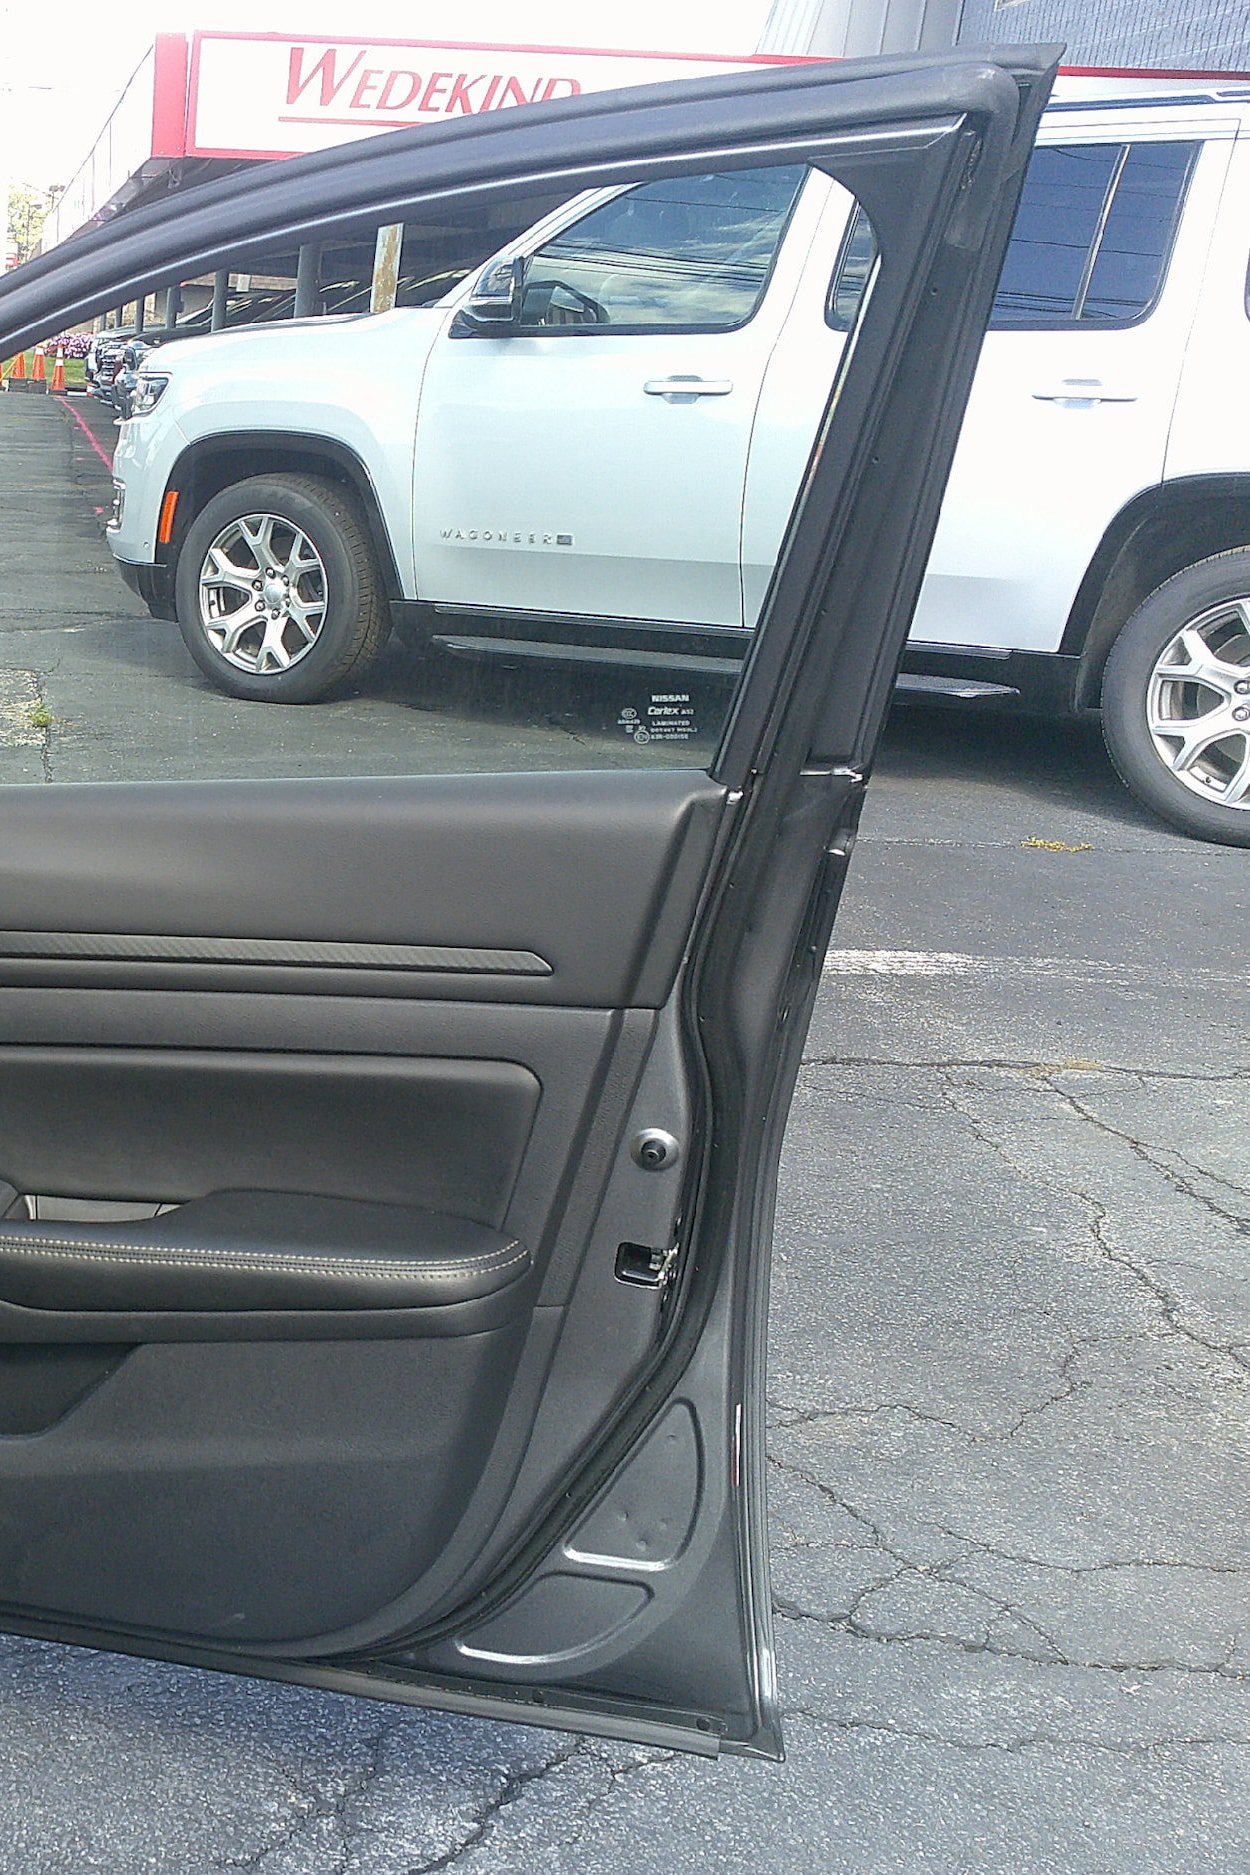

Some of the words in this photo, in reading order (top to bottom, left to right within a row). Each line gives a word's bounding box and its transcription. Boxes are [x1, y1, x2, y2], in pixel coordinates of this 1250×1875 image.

[286, 47, 581, 114] WEDEKIND
[440, 528, 553, 546] WAGONEER
[651, 695, 690, 703] NISSAN
